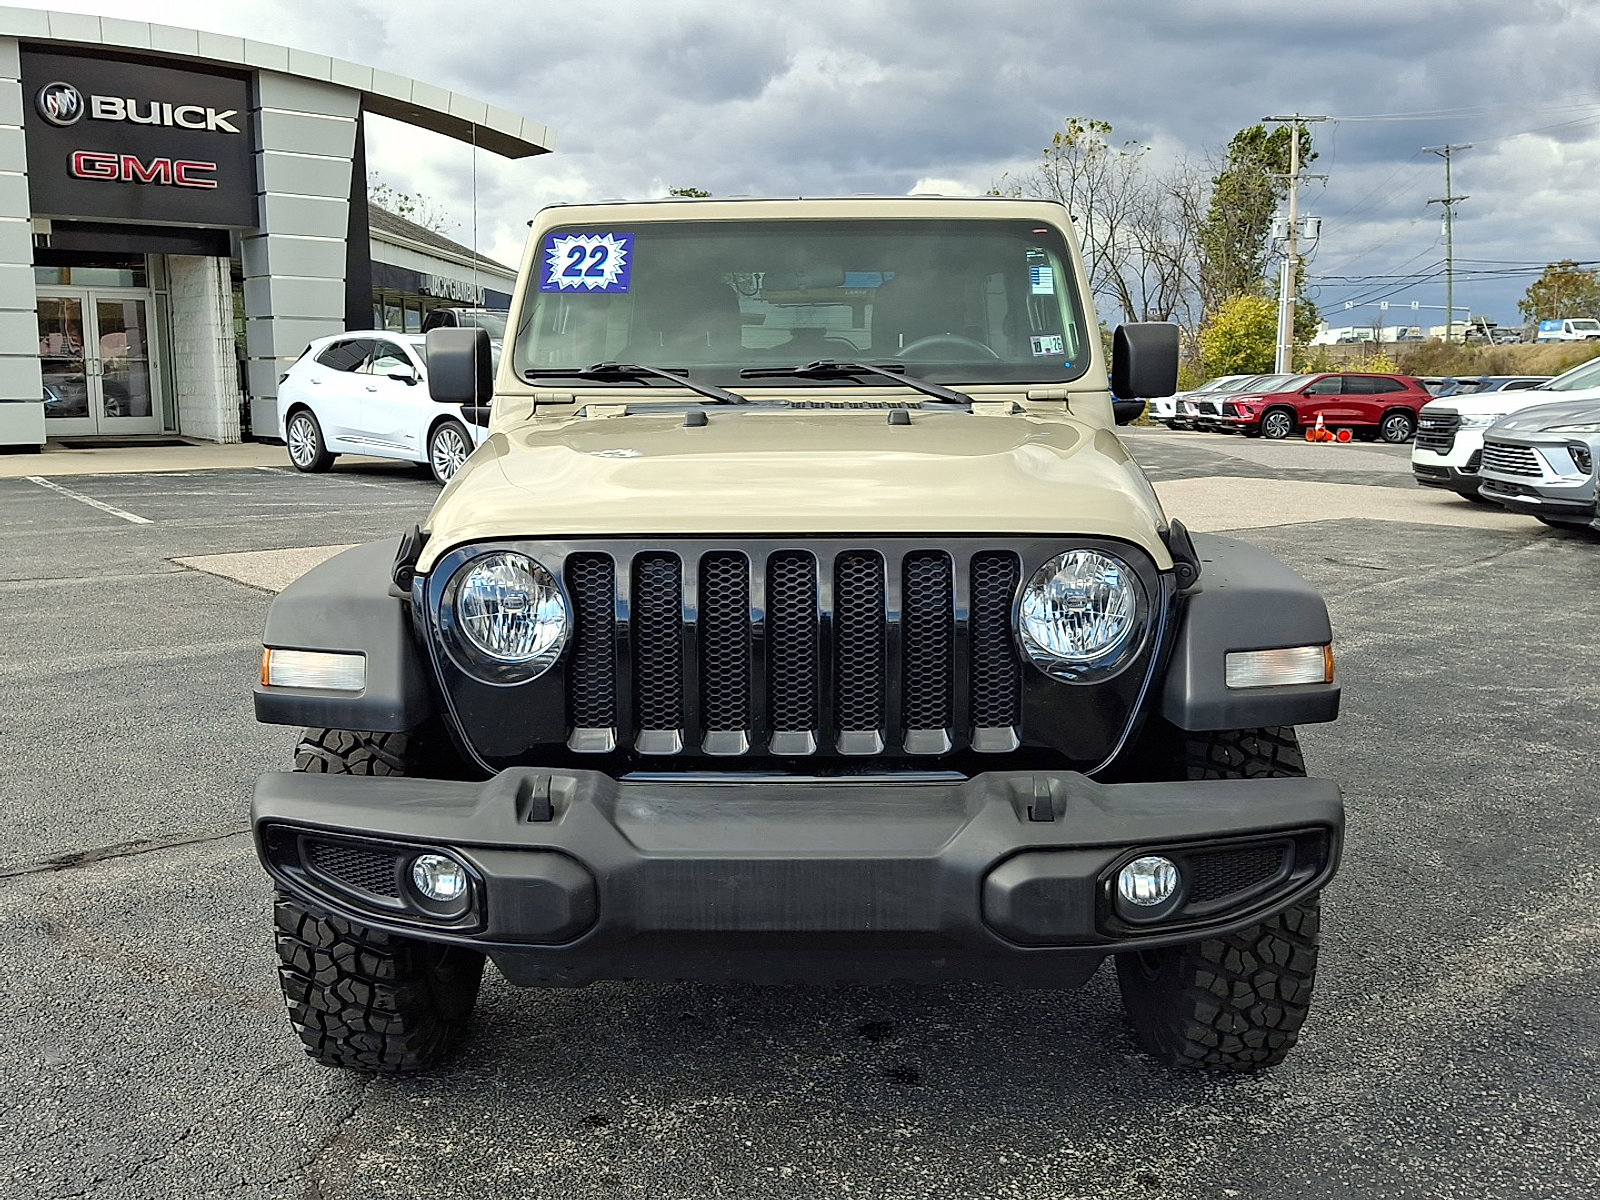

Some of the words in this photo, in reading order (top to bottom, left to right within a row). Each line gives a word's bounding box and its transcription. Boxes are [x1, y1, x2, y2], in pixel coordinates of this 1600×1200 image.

[91, 94, 241, 134] BUICK
[70, 150, 218, 189] GMC
[562, 244, 609, 277] 22
[429, 275, 450, 299] JACK
